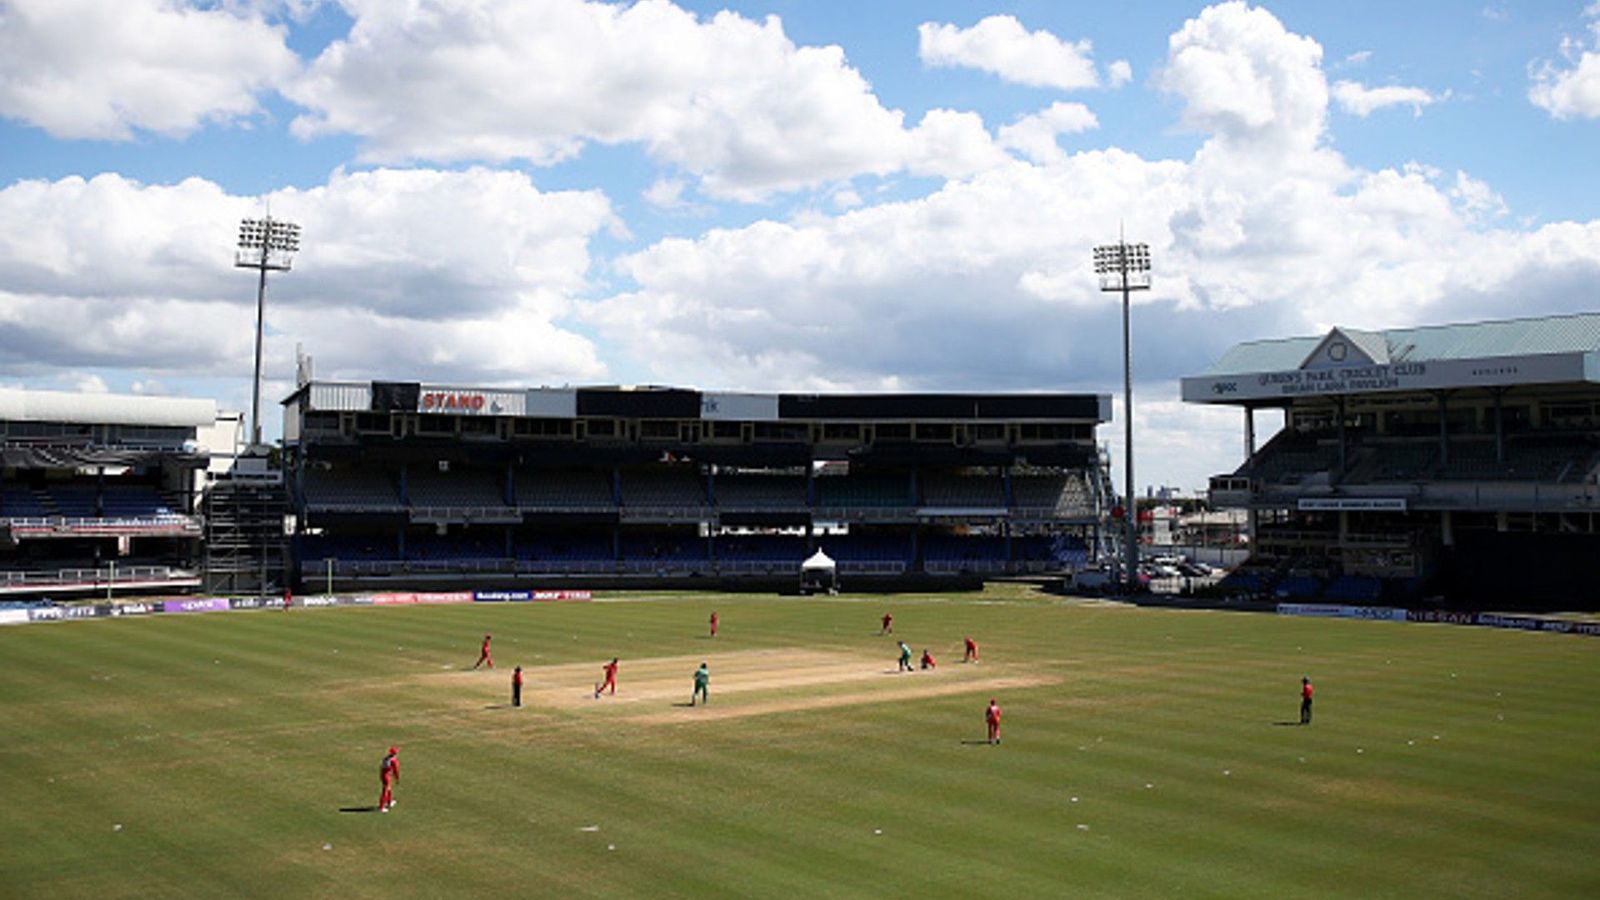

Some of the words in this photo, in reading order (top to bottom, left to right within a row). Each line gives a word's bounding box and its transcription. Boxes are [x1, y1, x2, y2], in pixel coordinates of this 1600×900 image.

[1305, 369, 1334, 382] PARK
[1338, 365, 1389, 379] CRICKET
[1394, 361, 1426, 376] CLUB
[423, 391, 484, 411] STAND
